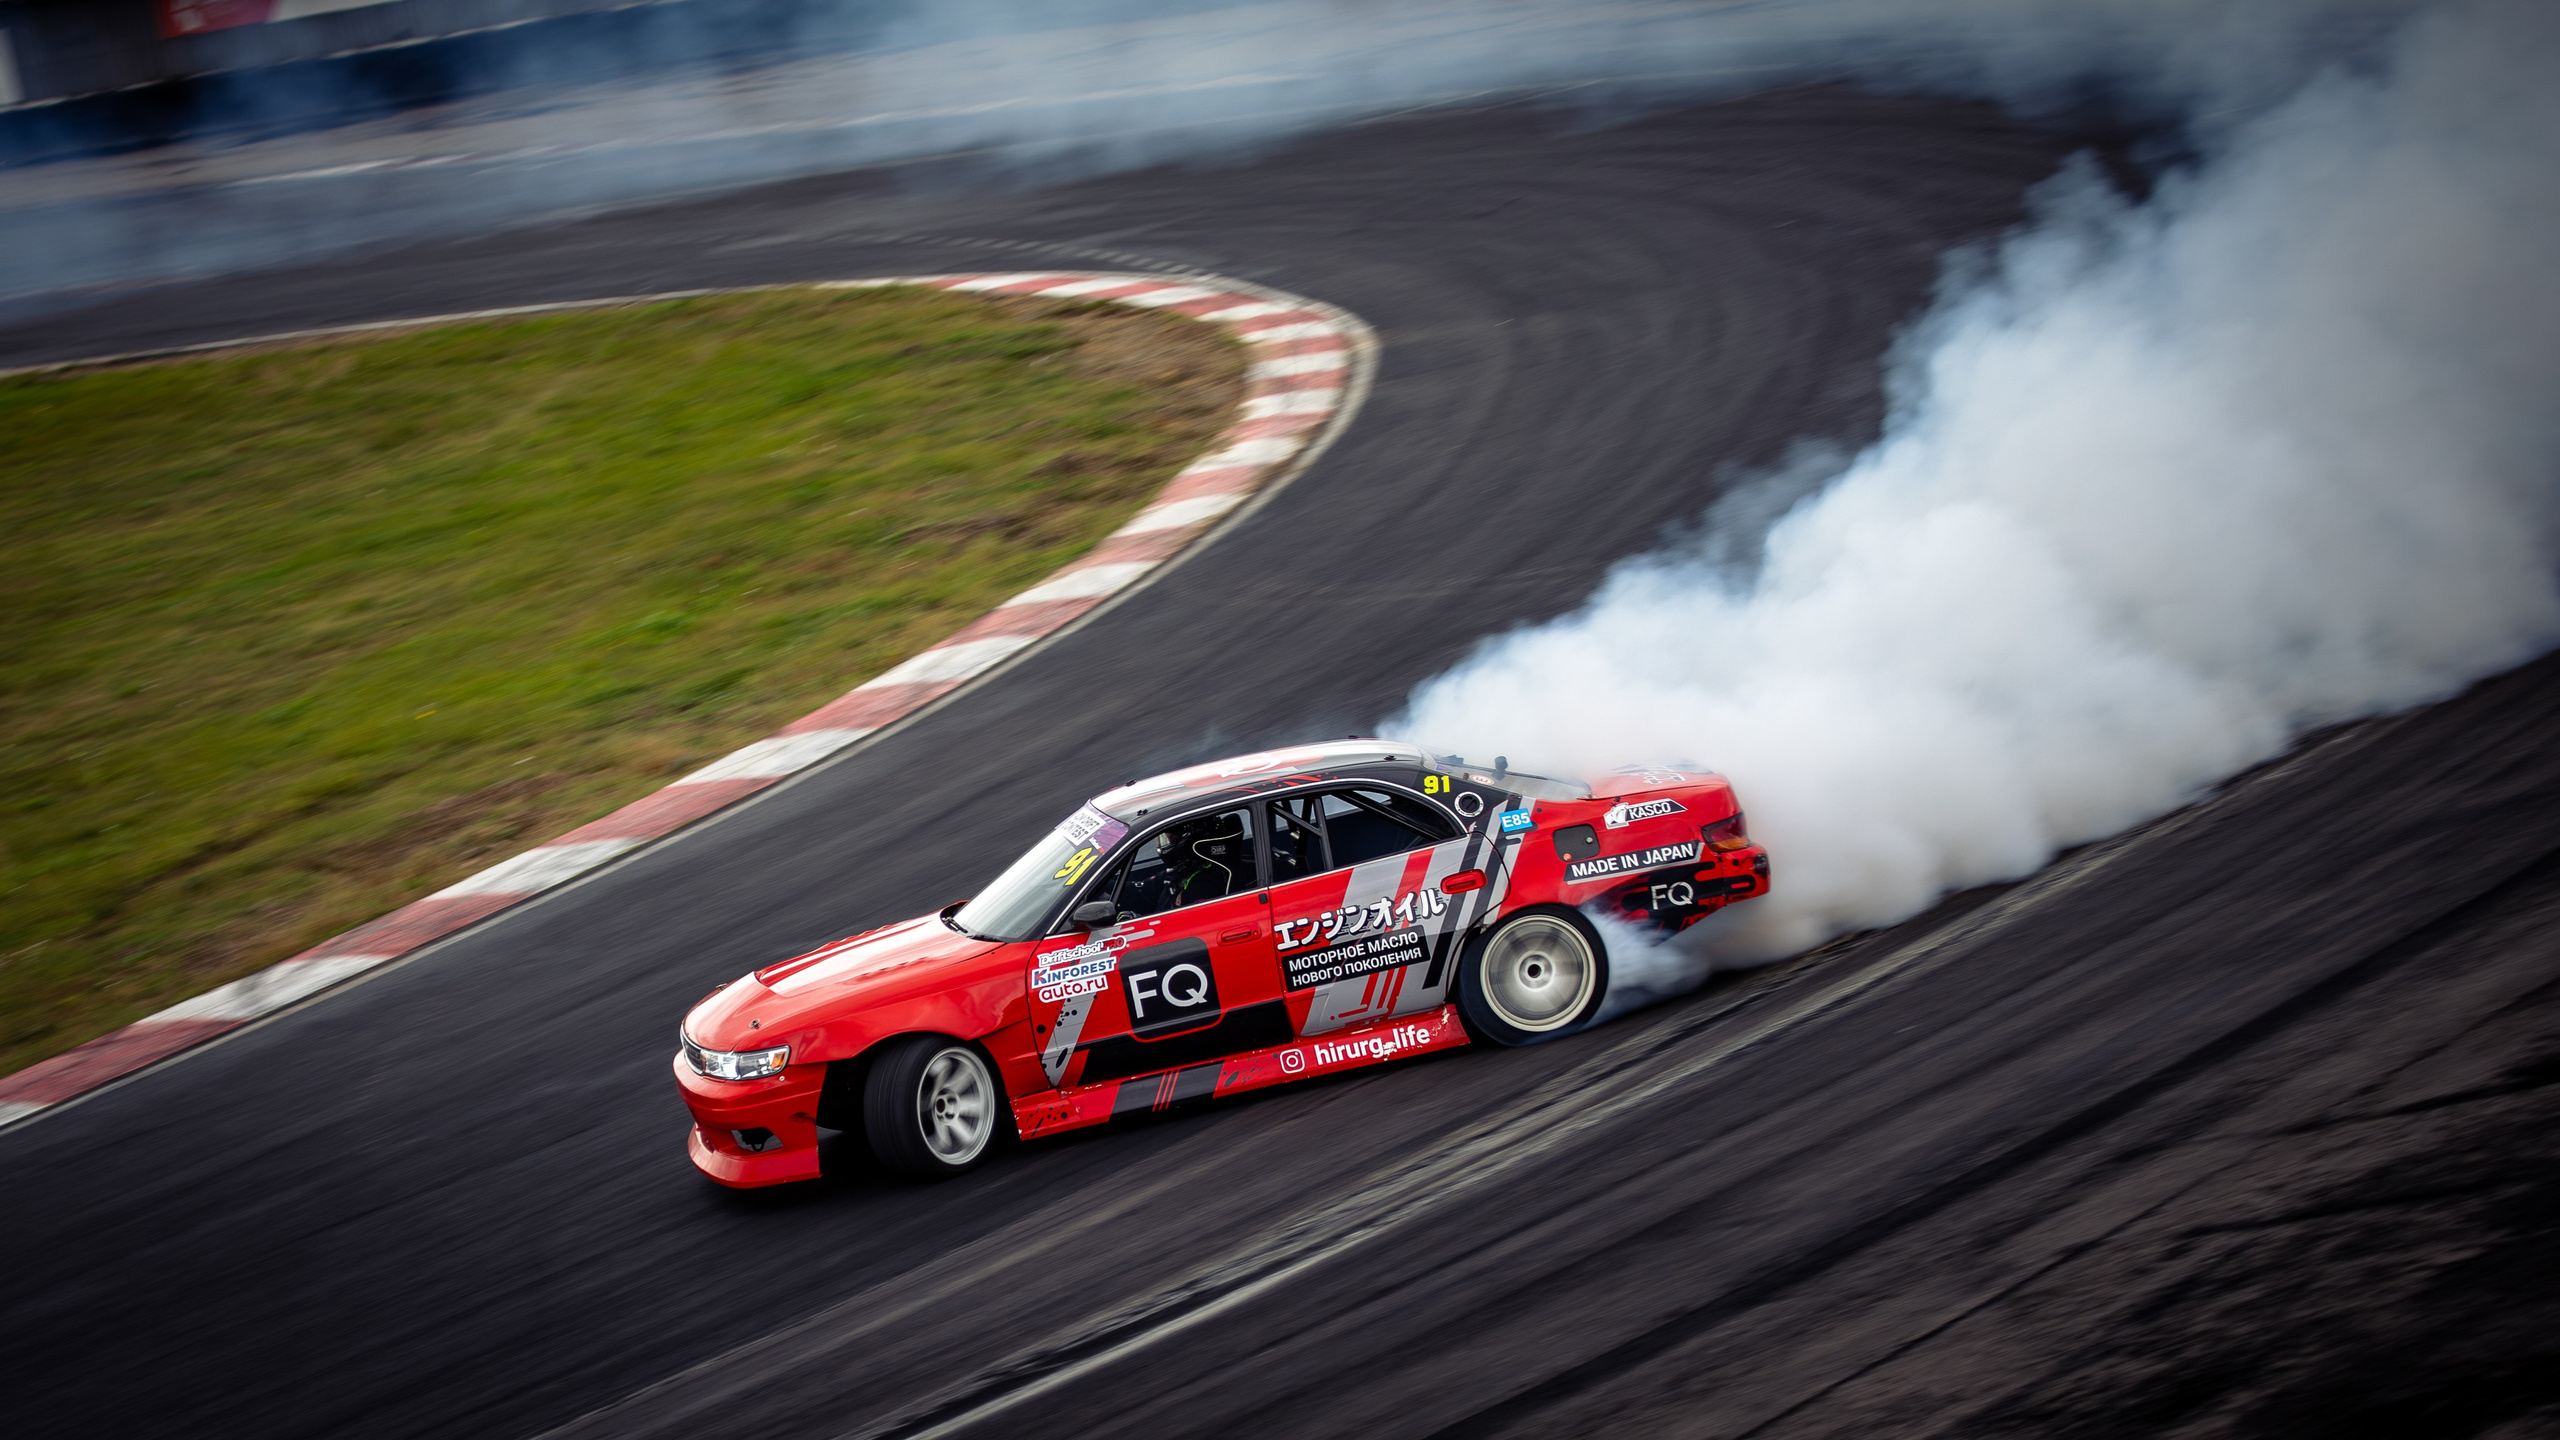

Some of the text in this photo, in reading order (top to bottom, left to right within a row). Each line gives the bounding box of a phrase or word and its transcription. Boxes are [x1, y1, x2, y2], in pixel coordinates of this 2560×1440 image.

[1424, 775, 1450, 794] 91
[1501, 812, 1531, 829] E85
[1629, 802, 1671, 819] KASCO
[1054, 847, 1099, 886] 91
[1571, 843, 1694, 877] MADE IN JAPAN
[1651, 881, 1694, 910] FQ
[1273, 888, 1445, 950] エンジンオイル
[1289, 931, 1418, 972] МОТОРНОЕ МАСЛО
[1292, 947, 1422, 987] НОВОГО ПОКОЛЕНИЯ
[1034, 959, 1114, 986] KINFOREST
[1041, 977, 1106, 1000] auto.ru
[1129, 964, 1207, 1018] FQ
[1314, 1024, 1430, 1065] hirurg_life
